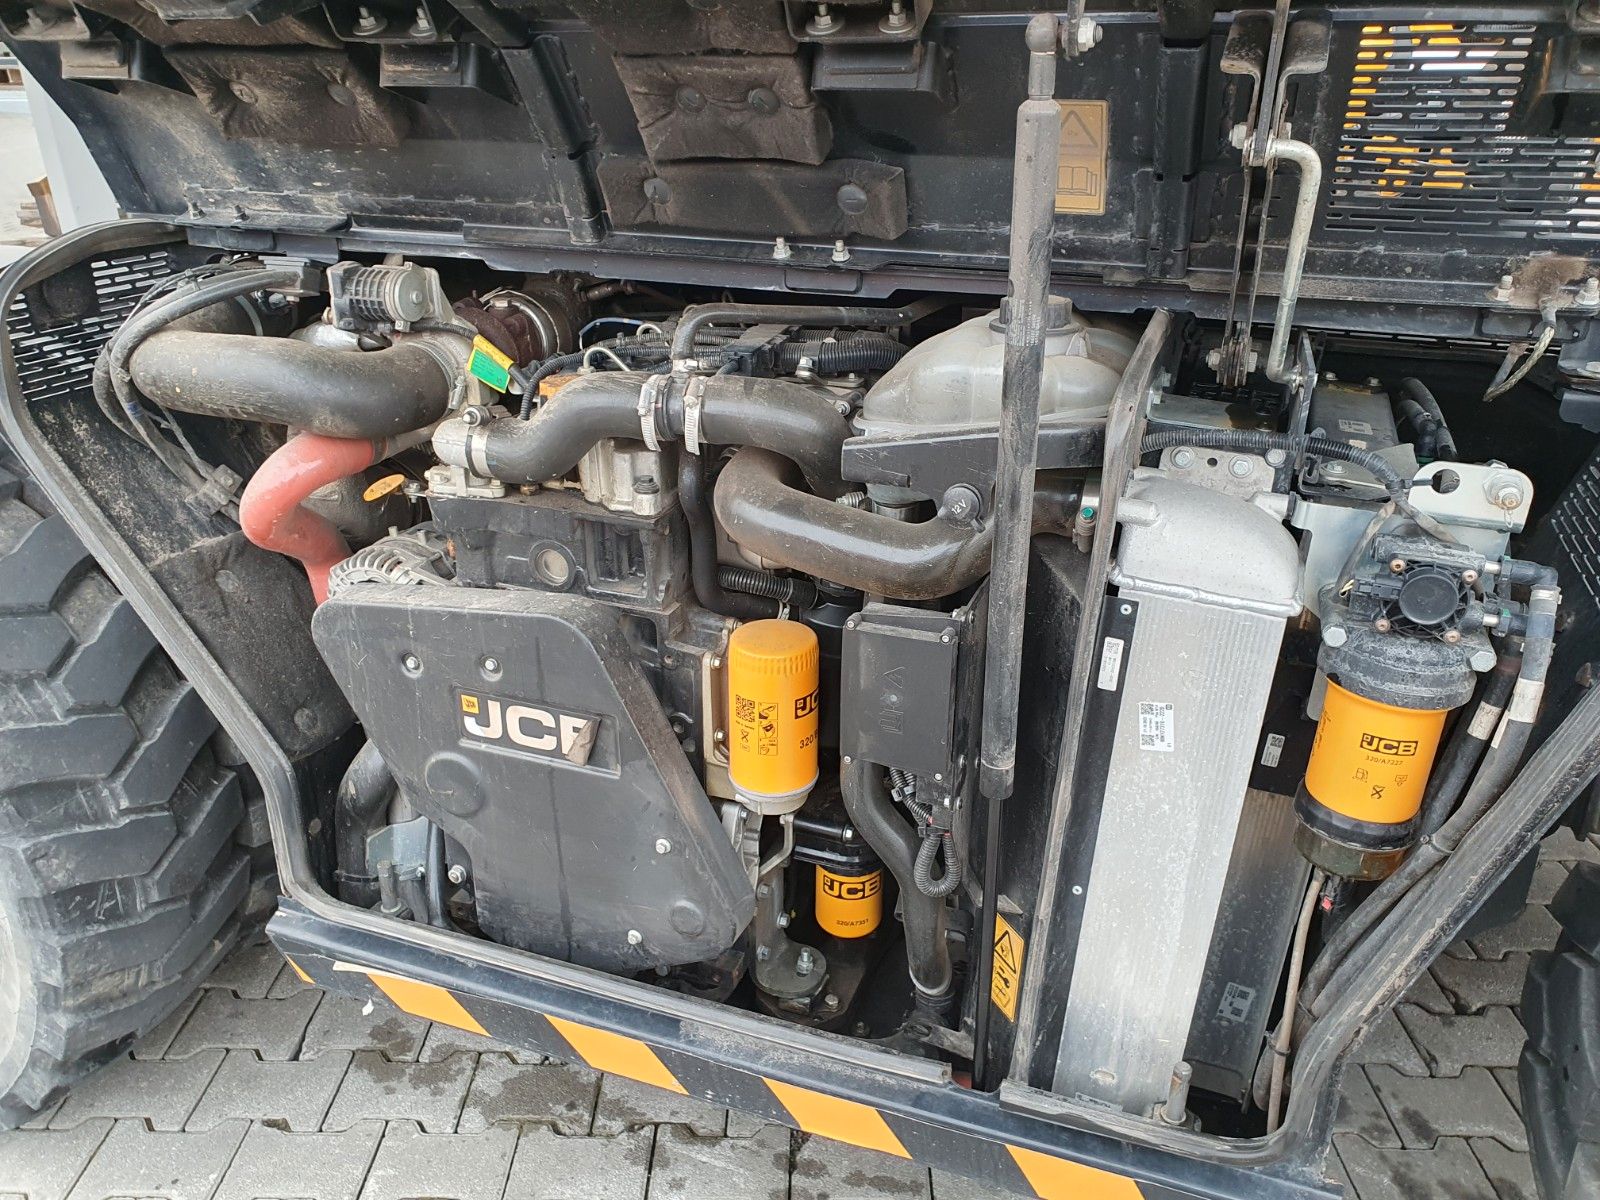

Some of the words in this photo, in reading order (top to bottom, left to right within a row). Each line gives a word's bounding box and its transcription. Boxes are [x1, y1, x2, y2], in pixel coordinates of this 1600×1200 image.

[951, 499, 967, 515] 12V
[1361, 733, 1418, 756] JCB
[824, 875, 880, 900] JCB
